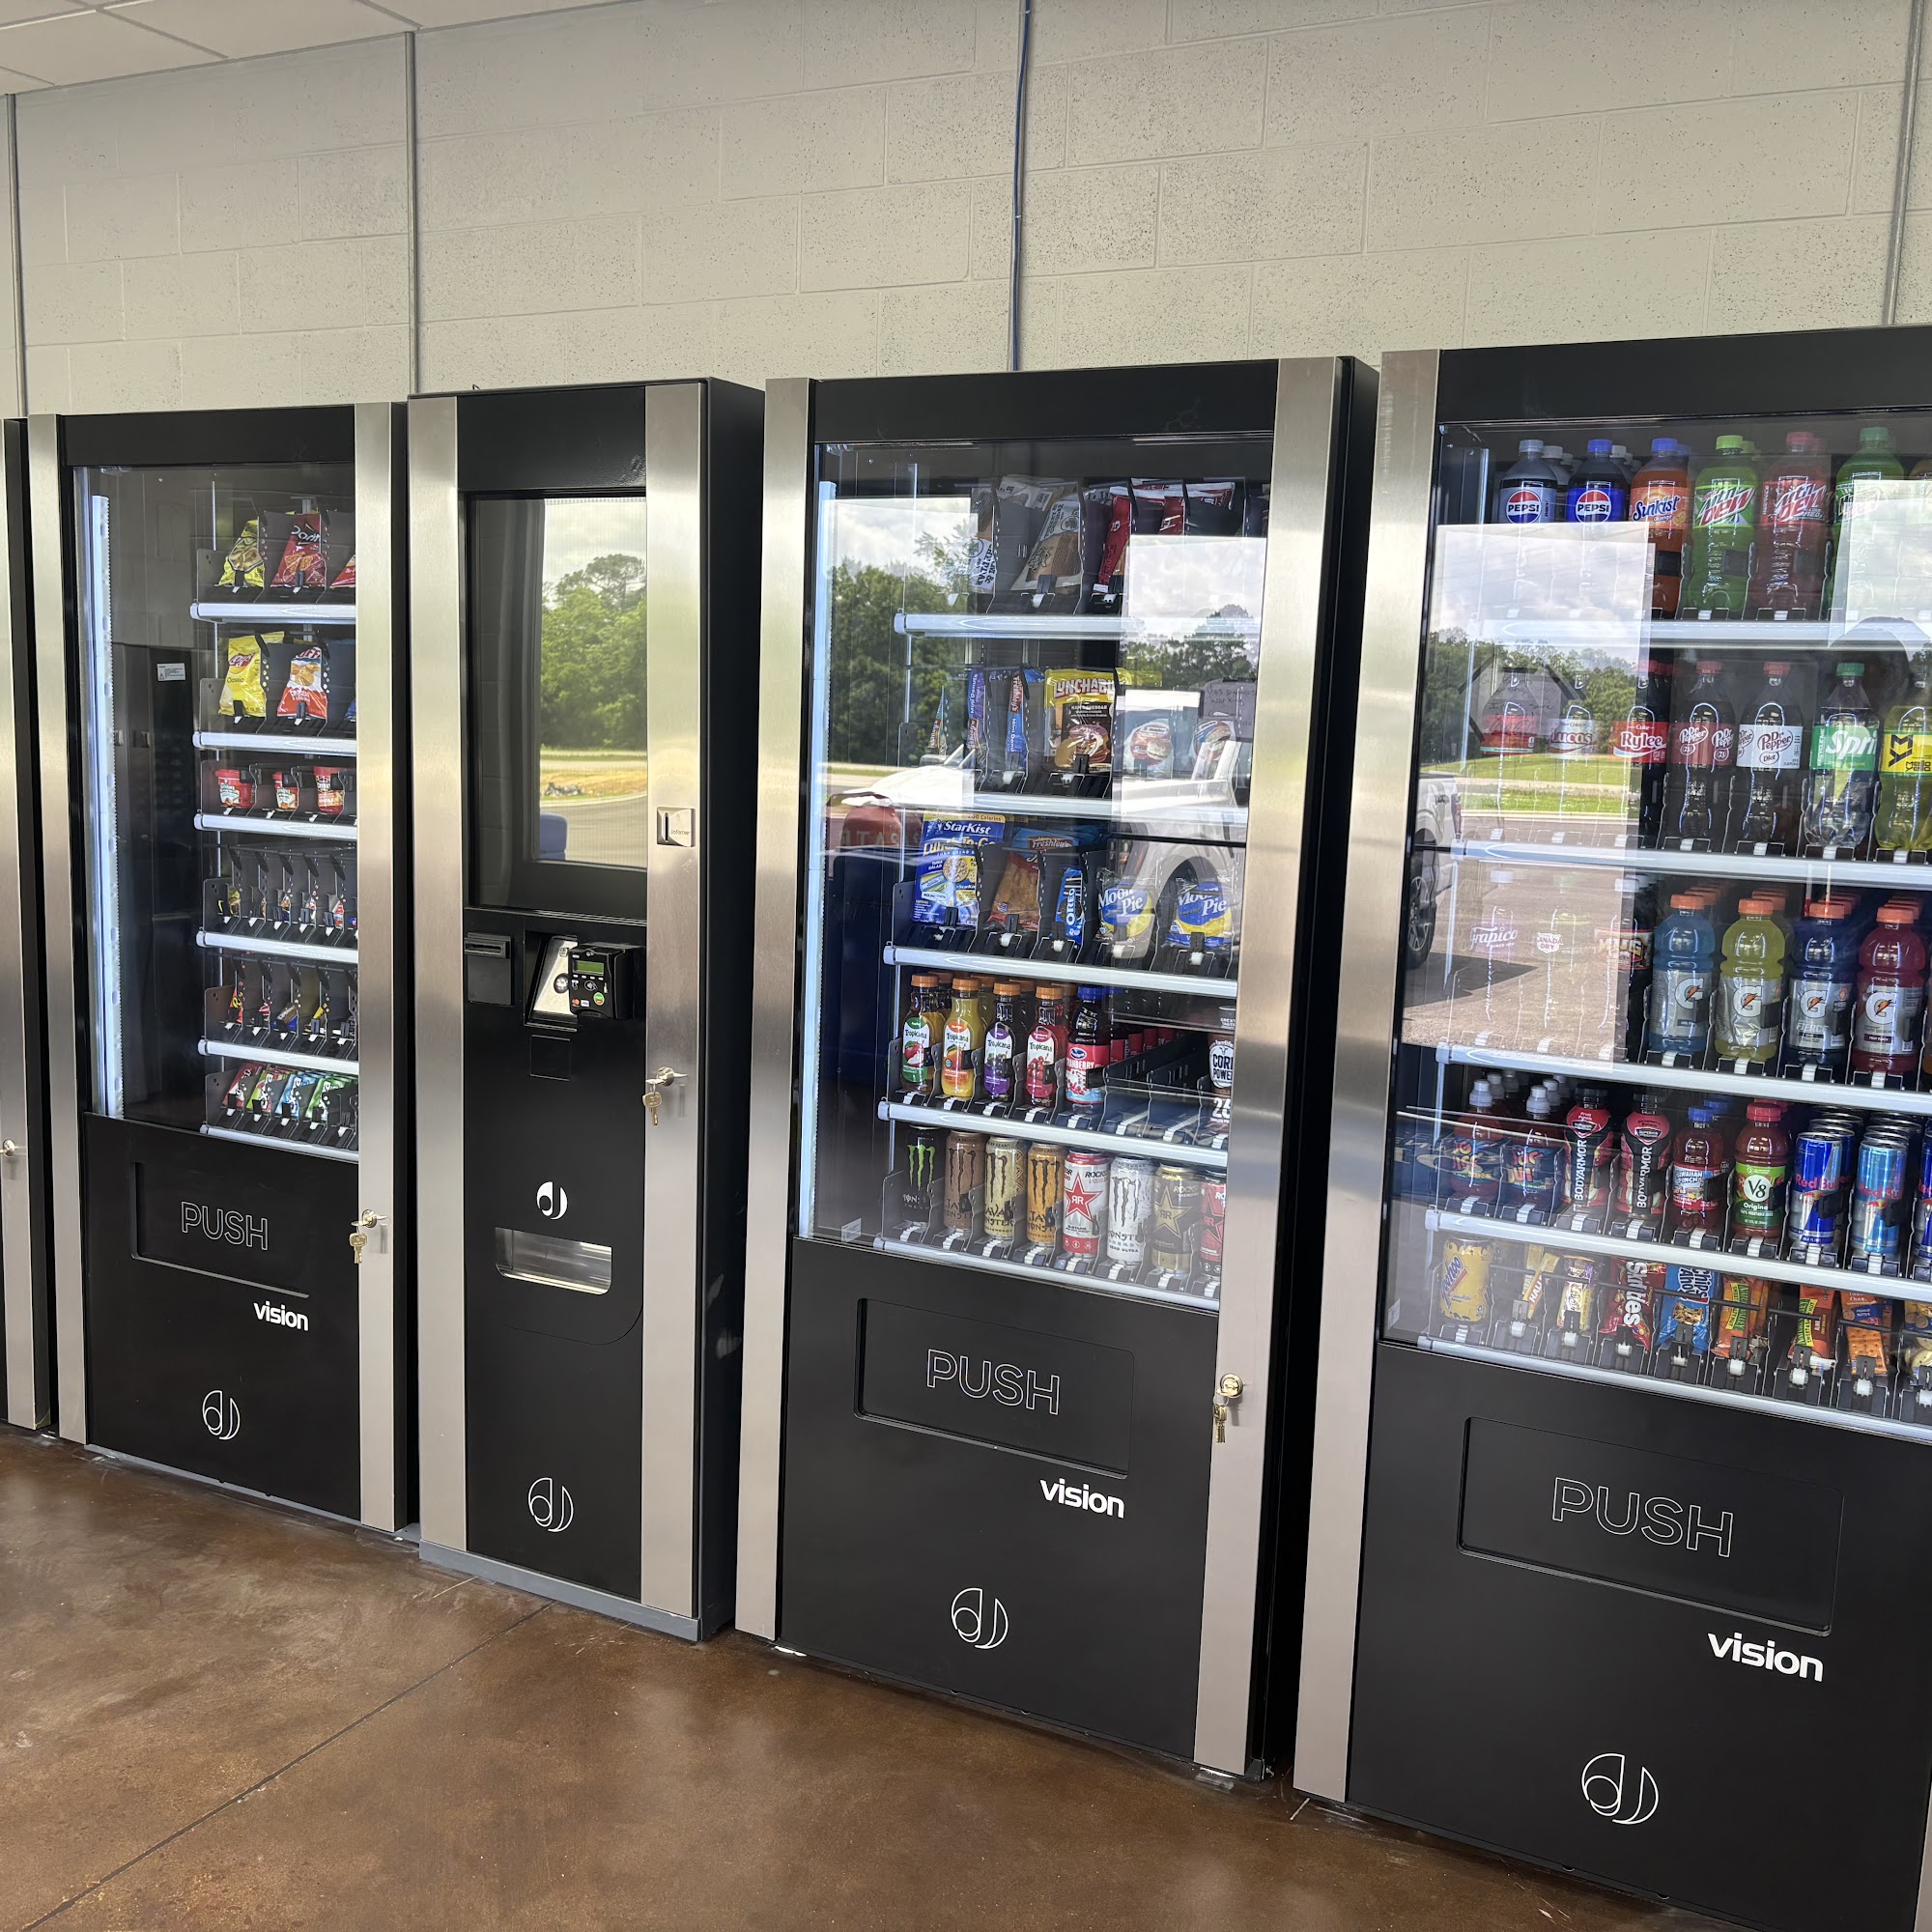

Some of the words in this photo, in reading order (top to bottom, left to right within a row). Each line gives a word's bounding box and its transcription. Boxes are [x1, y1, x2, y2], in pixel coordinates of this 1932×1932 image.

[1507, 504, 1540, 512] PEPSI
[1577, 504, 1609, 512] PEPSI
[1633, 496, 1681, 521] Sunkist
[229, 653, 254, 667] Lay's
[1550, 728, 1593, 745] Lucas
[1680, 728, 1707, 744] Pepper
[1688, 725, 1700, 736] Dr
[1723, 728, 1733, 740] Dr
[1771, 731, 1785, 743] Dr
[1621, 731, 1663, 752] Rylee
[1761, 733, 1792, 751] Pepper
[1826, 729, 1877, 760] Spri
[944, 821, 992, 835] StarKist
[1065, 888, 1076, 926] OREO
[1121, 895, 1143, 916] Pie
[1201, 897, 1227, 917] Pie
[1598, 937, 1643, 956] MUG
[1574, 1139, 1587, 1200] BODYARMOR
[1747, 1179, 1767, 1198] V8
[1795, 1173, 1818, 1190] Red
[1859, 1181, 1881, 1199] Red
[1743, 1202, 1768, 1210] Origina
[181, 1201, 269, 1250] PUSH
[253, 1301, 309, 1332] vision
[926, 1348, 1061, 1416] PUSH
[1039, 1477, 1125, 1520] vision
[1552, 1477, 1734, 1559] PUSH
[1707, 1631, 1824, 1682] vision
